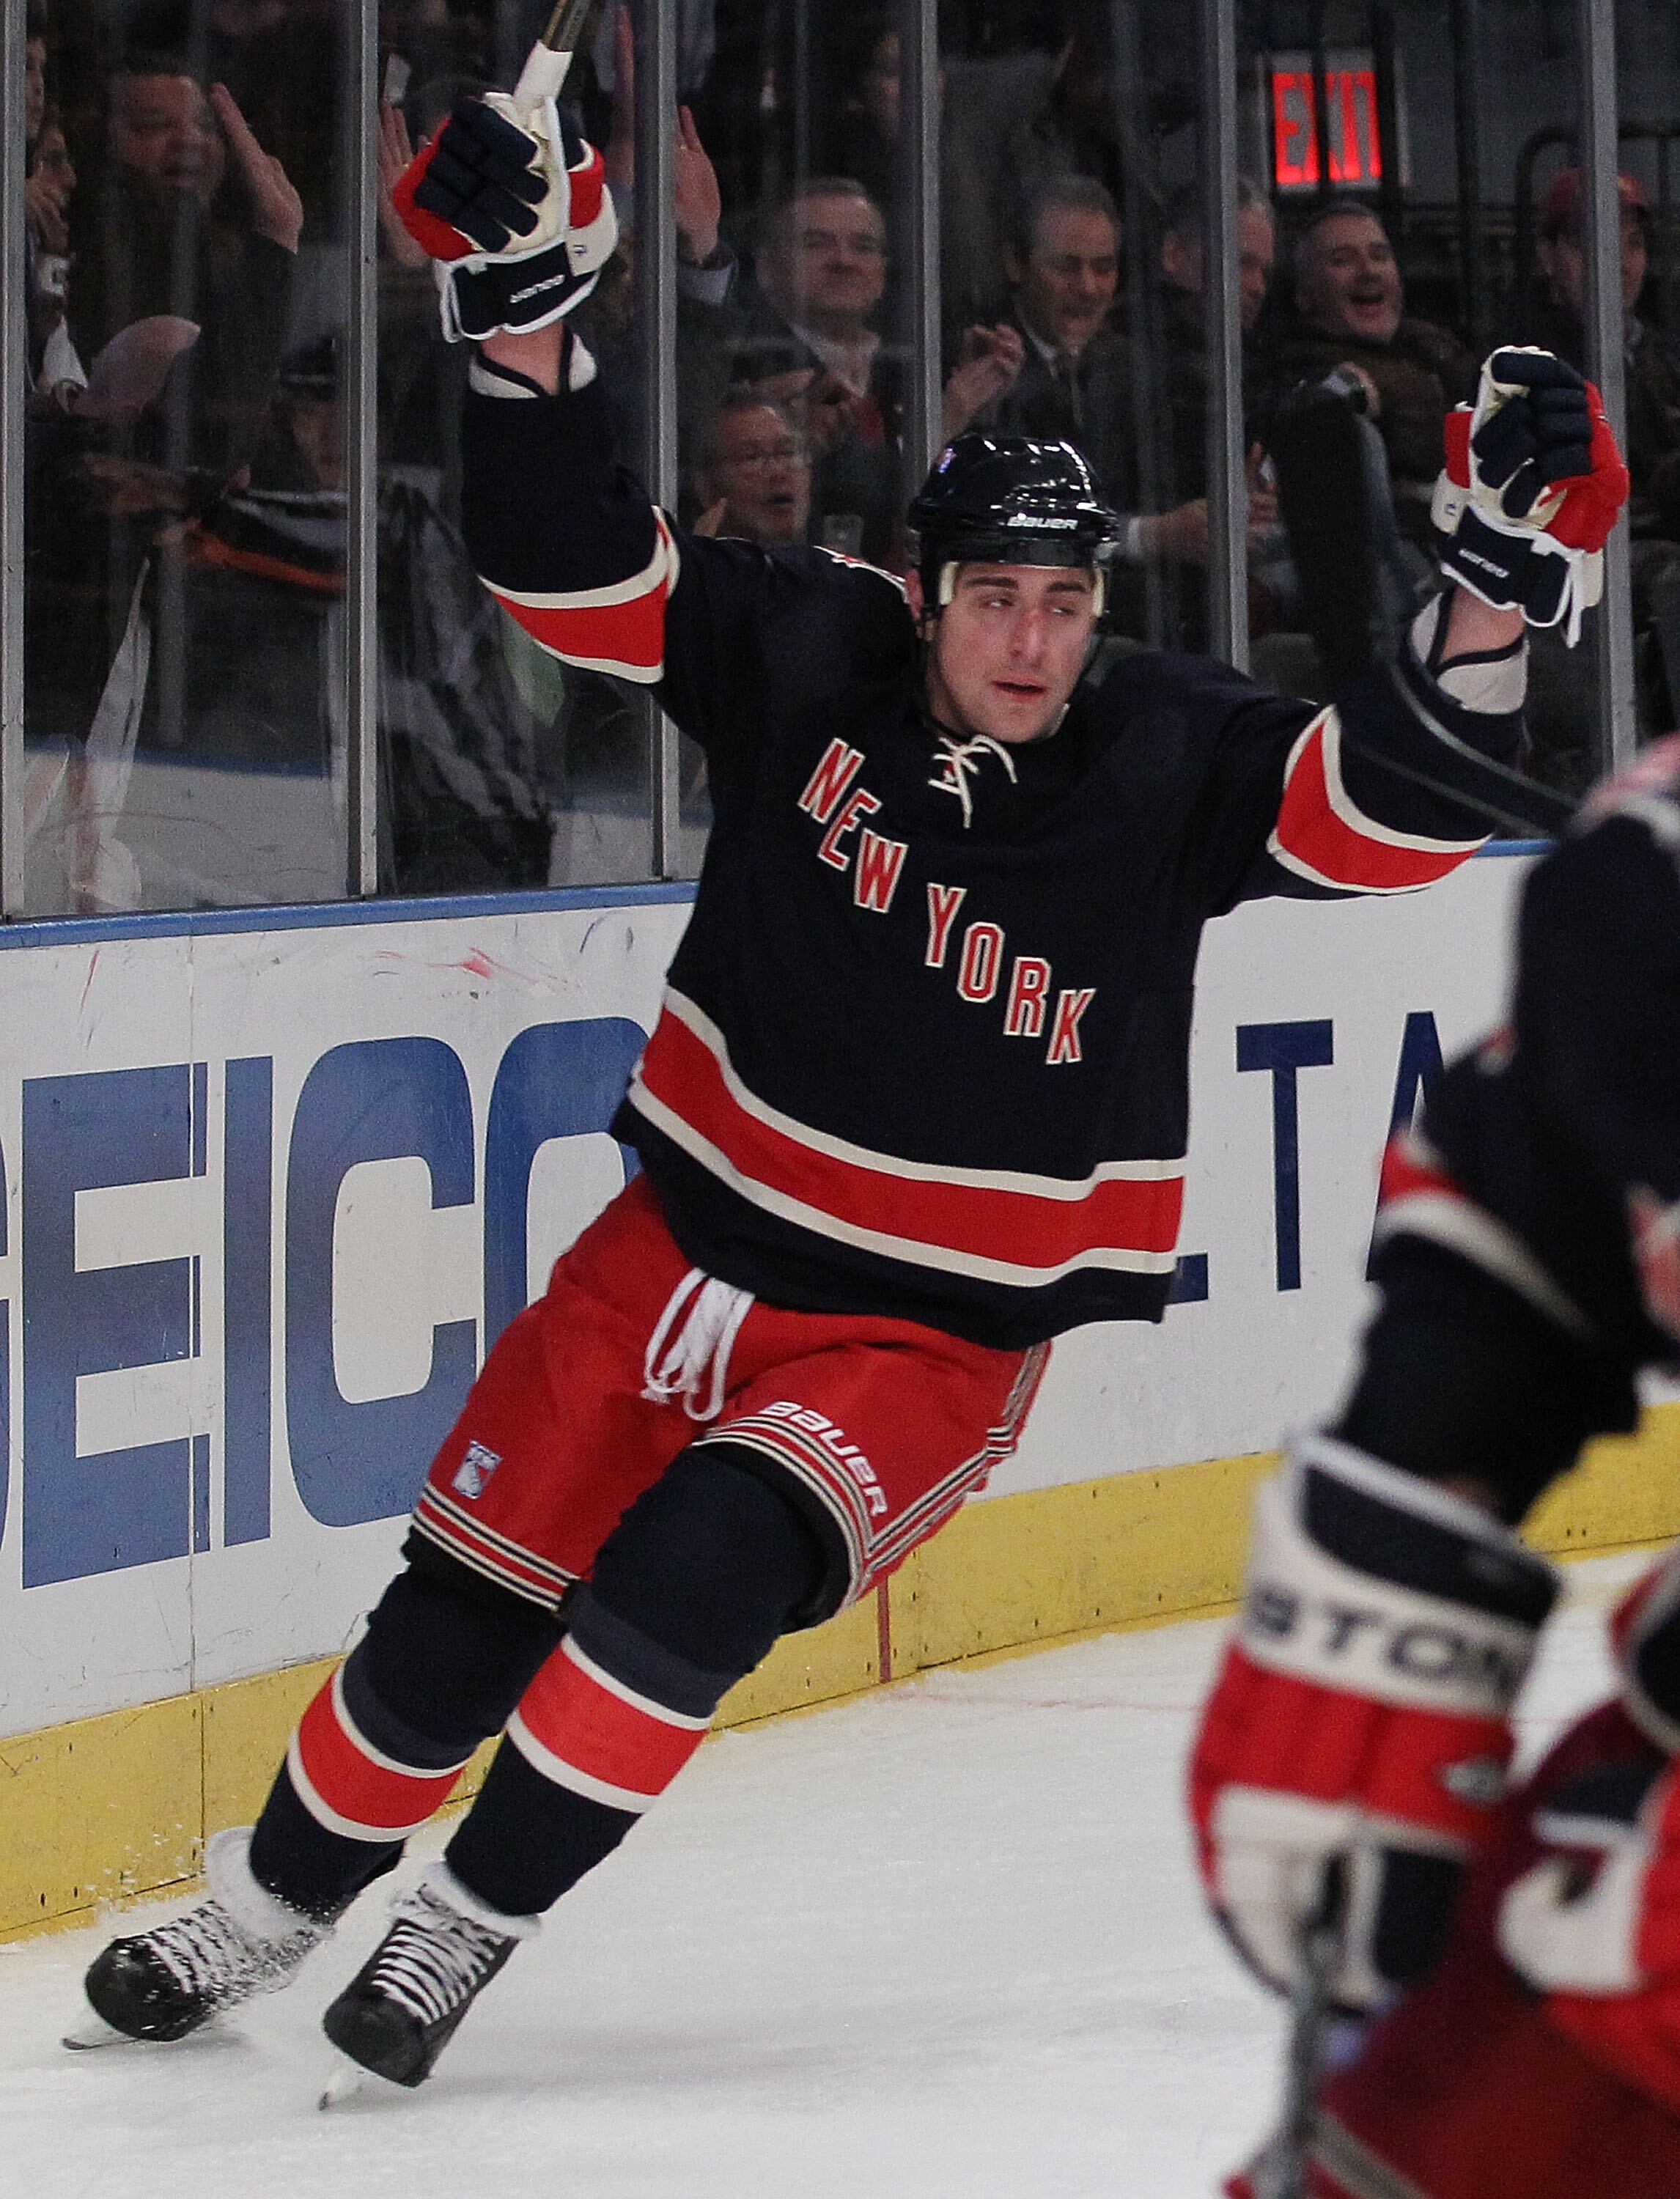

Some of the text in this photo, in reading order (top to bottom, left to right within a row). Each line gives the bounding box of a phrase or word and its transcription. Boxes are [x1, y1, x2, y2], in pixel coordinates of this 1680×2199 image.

[1272, 70, 1381, 184] EXIT
[797, 738, 1097, 1065] NEW YORK
[0, 1016, 649, 1589] EIC
[757, 1401, 888, 1517] BAUER
